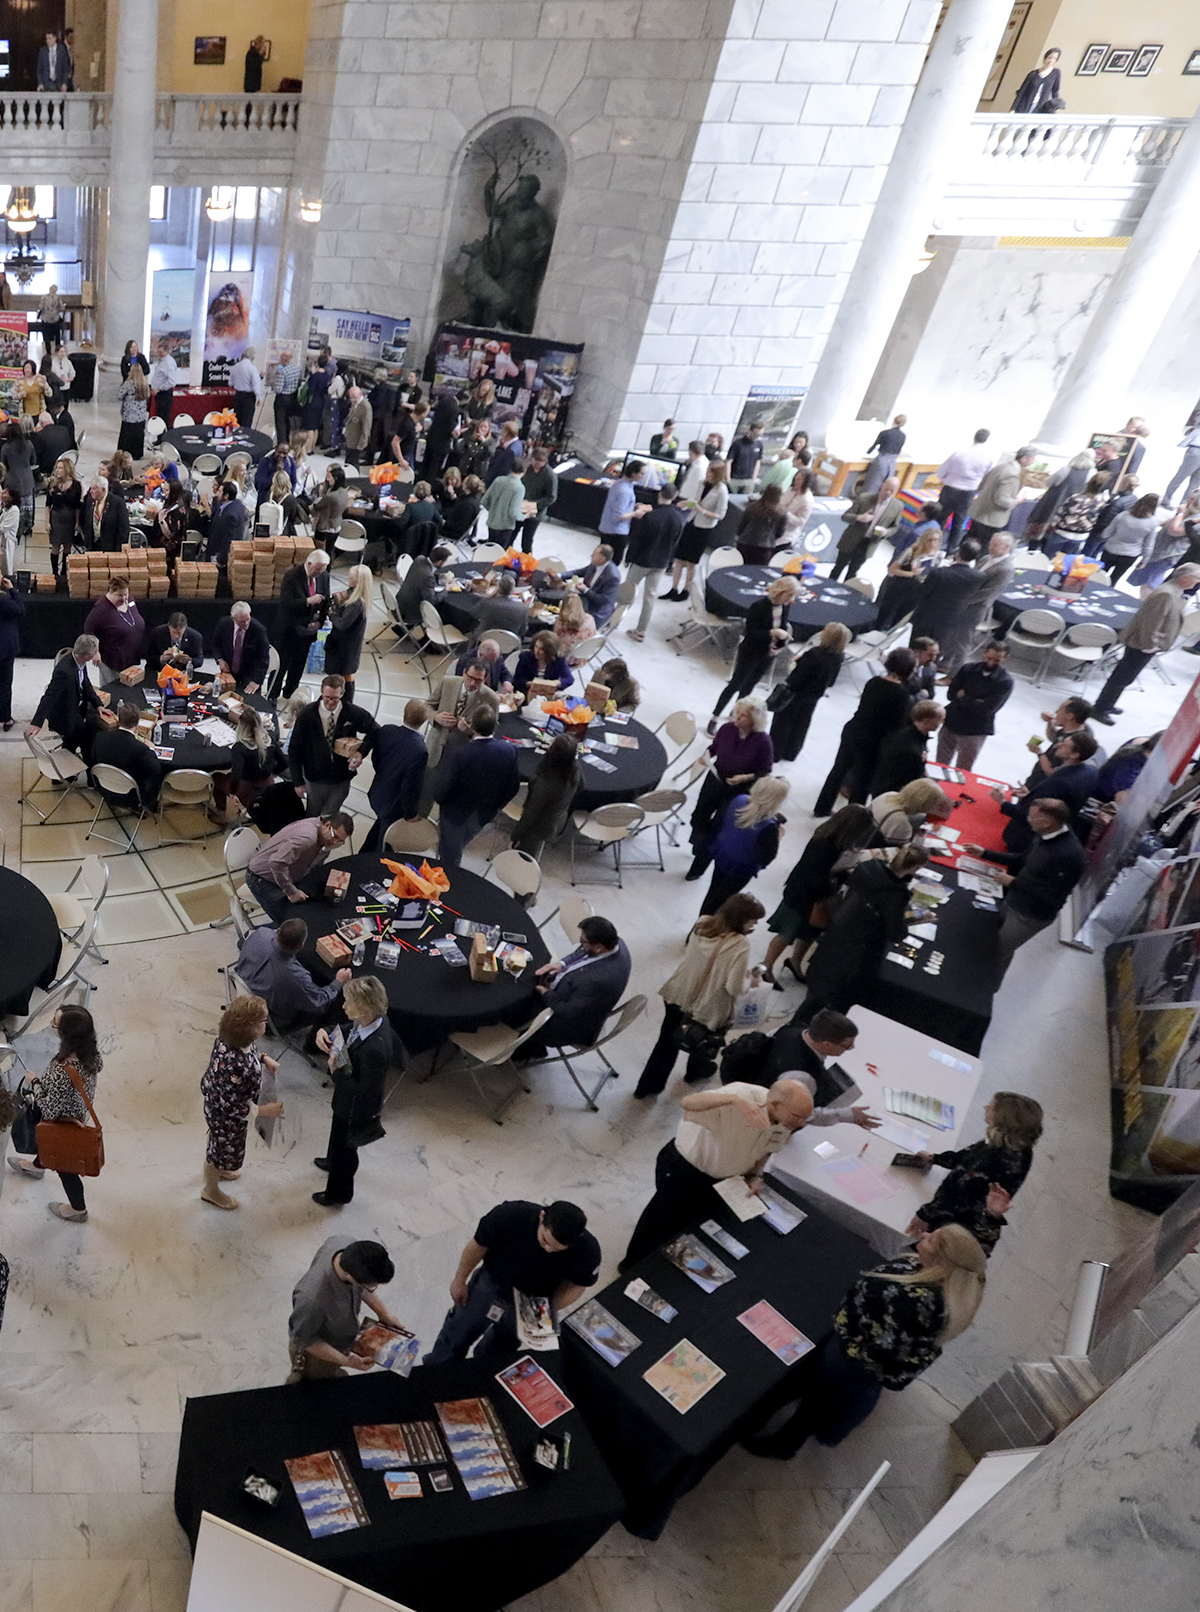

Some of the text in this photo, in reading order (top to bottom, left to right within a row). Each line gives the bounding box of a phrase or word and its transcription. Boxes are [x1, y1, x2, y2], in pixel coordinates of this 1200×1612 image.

[336, 318, 370, 333] SAY HELLO
[335, 329, 343, 338] TO
[354, 331, 368, 341] NEW
